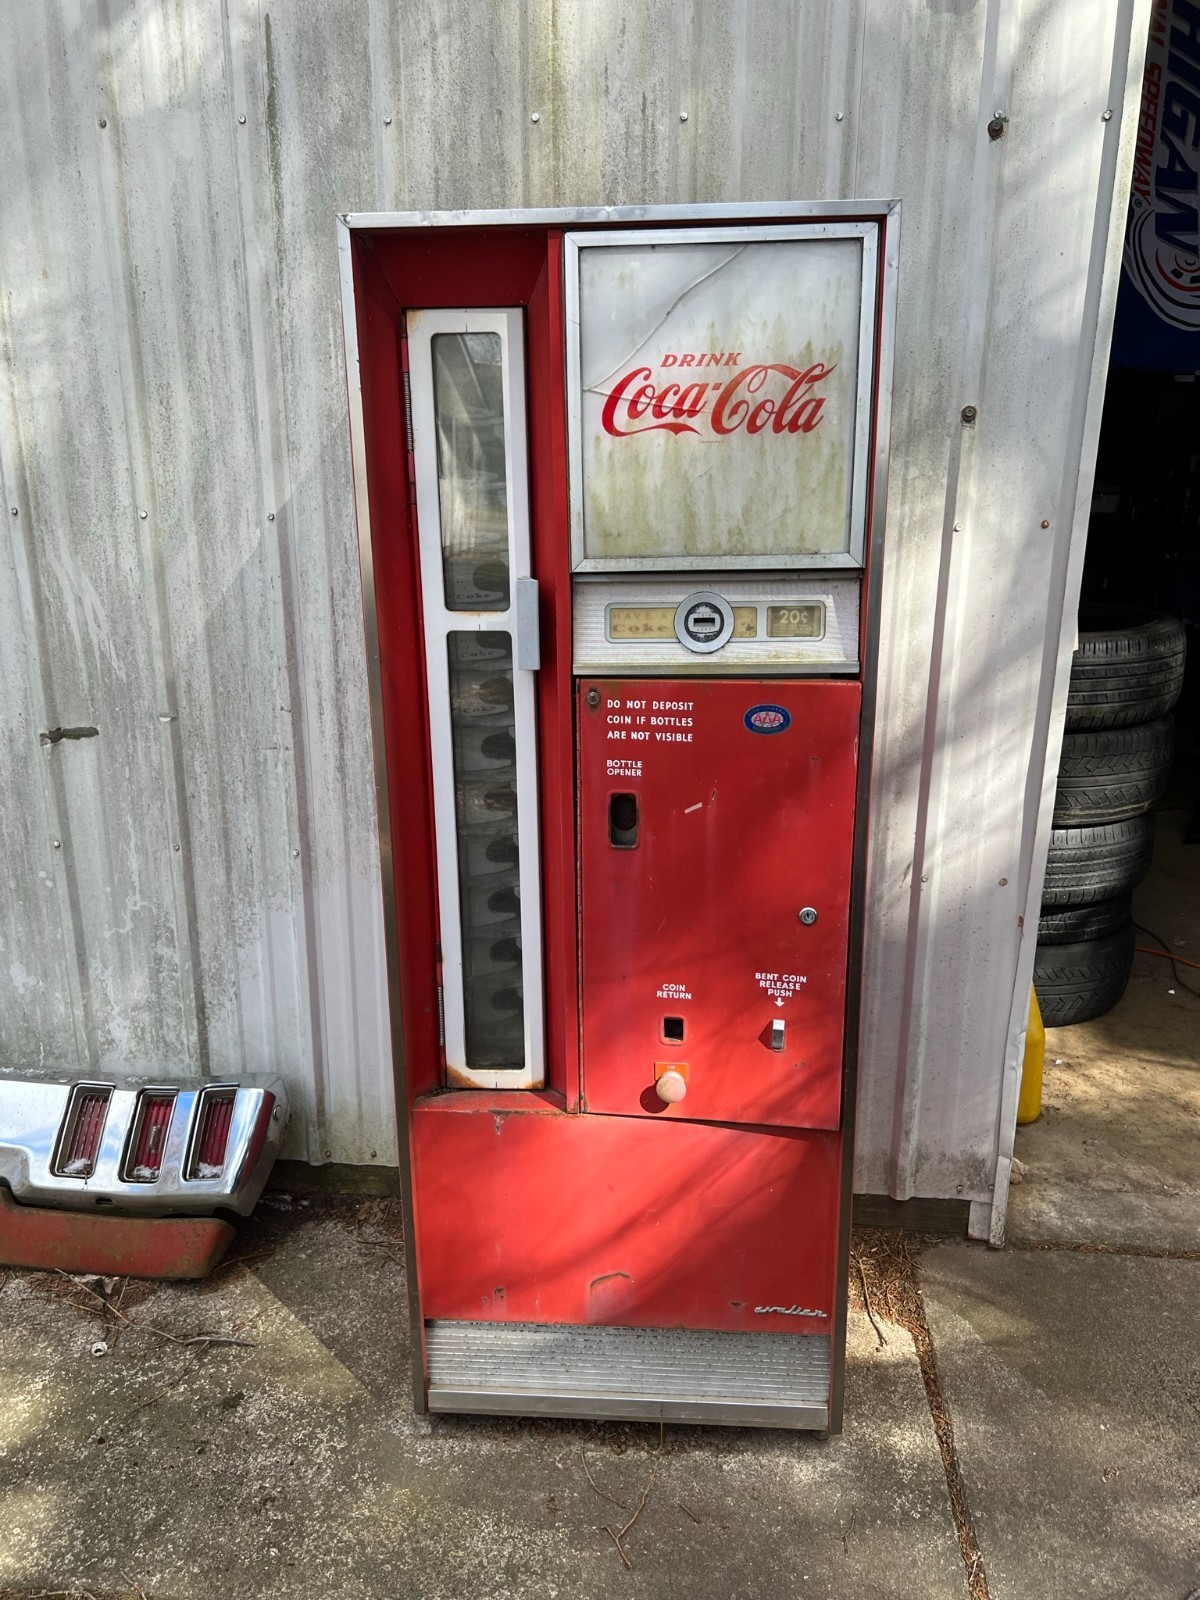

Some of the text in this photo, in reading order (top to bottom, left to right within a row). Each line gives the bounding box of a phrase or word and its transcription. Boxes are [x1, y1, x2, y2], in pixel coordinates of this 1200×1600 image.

[660, 352, 742, 368] DRINK
[602, 362, 838, 437] Coca-Cola
[779, 609, 809, 624] 20¢
[612, 623, 669, 632] Coke
[607, 699, 694, 711] DO NOT DEPOSIT
[607, 715, 694, 727] COIN IF BOTTLES
[754, 711, 782, 725] AAA
[606, 730, 693, 742] ARE NOT VISIBLE
[606, 759, 643, 769] BOTTLE
[606, 768, 642, 777] OPENER
[755, 972, 807, 983] BENT COIN
[662, 983, 686, 992] COIN
[759, 980, 801, 991] RELEASE
[656, 990, 692, 1000] RETURN
[767, 988, 793, 998] PUSH
